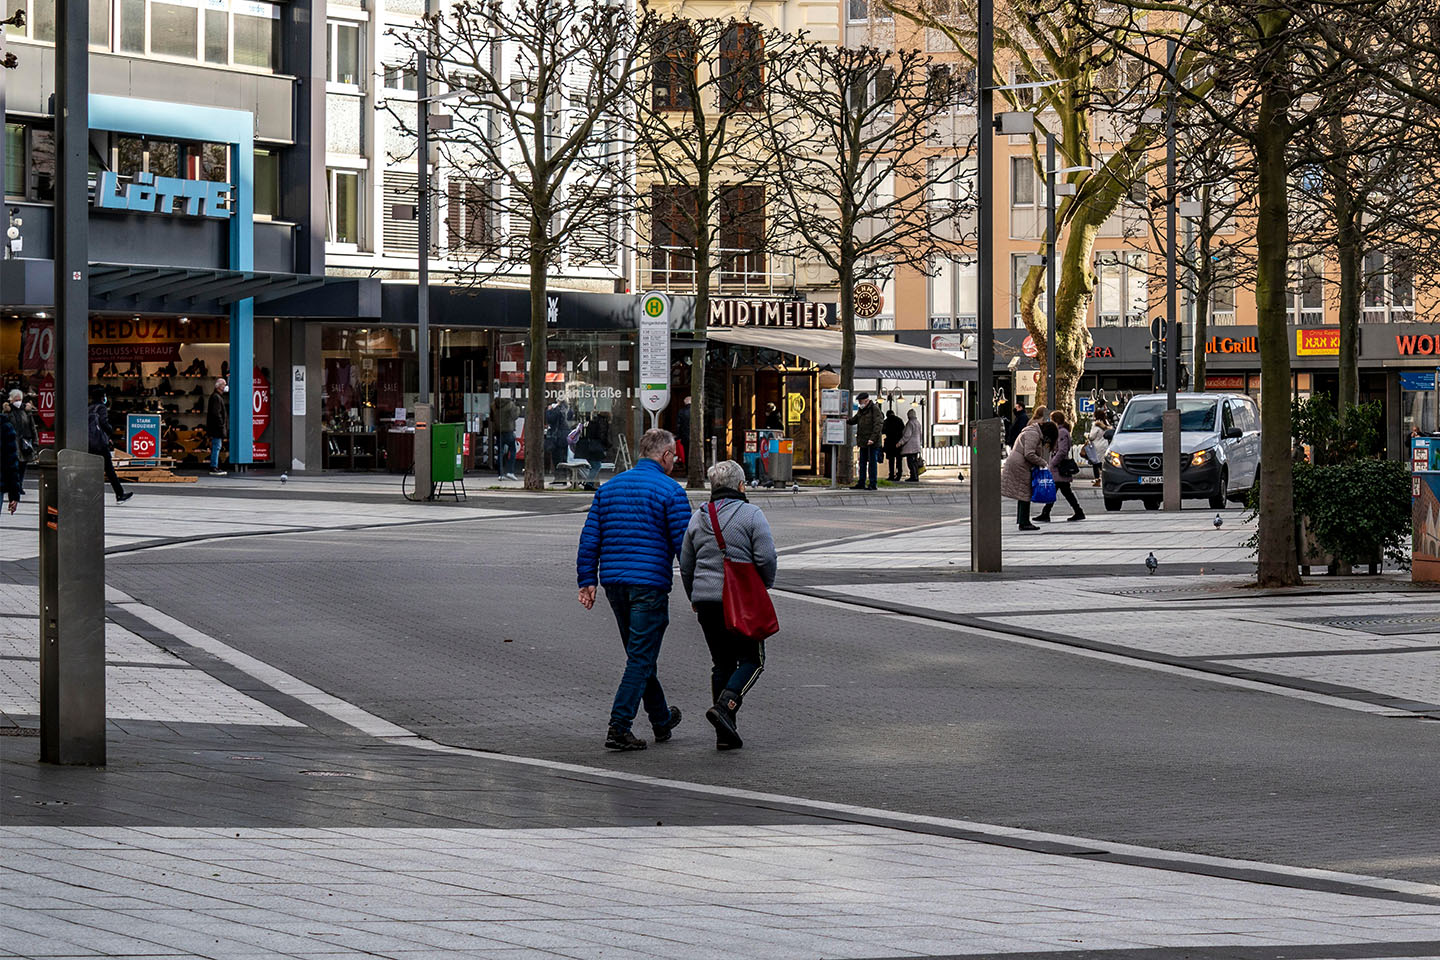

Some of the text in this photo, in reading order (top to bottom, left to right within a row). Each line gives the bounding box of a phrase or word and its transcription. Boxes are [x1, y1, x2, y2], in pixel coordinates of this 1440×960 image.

[97, 171, 230, 218] LÖTTE
[879, 369, 937, 380] SCHMIDTMEIER
[133, 440, 155, 451] 50%
